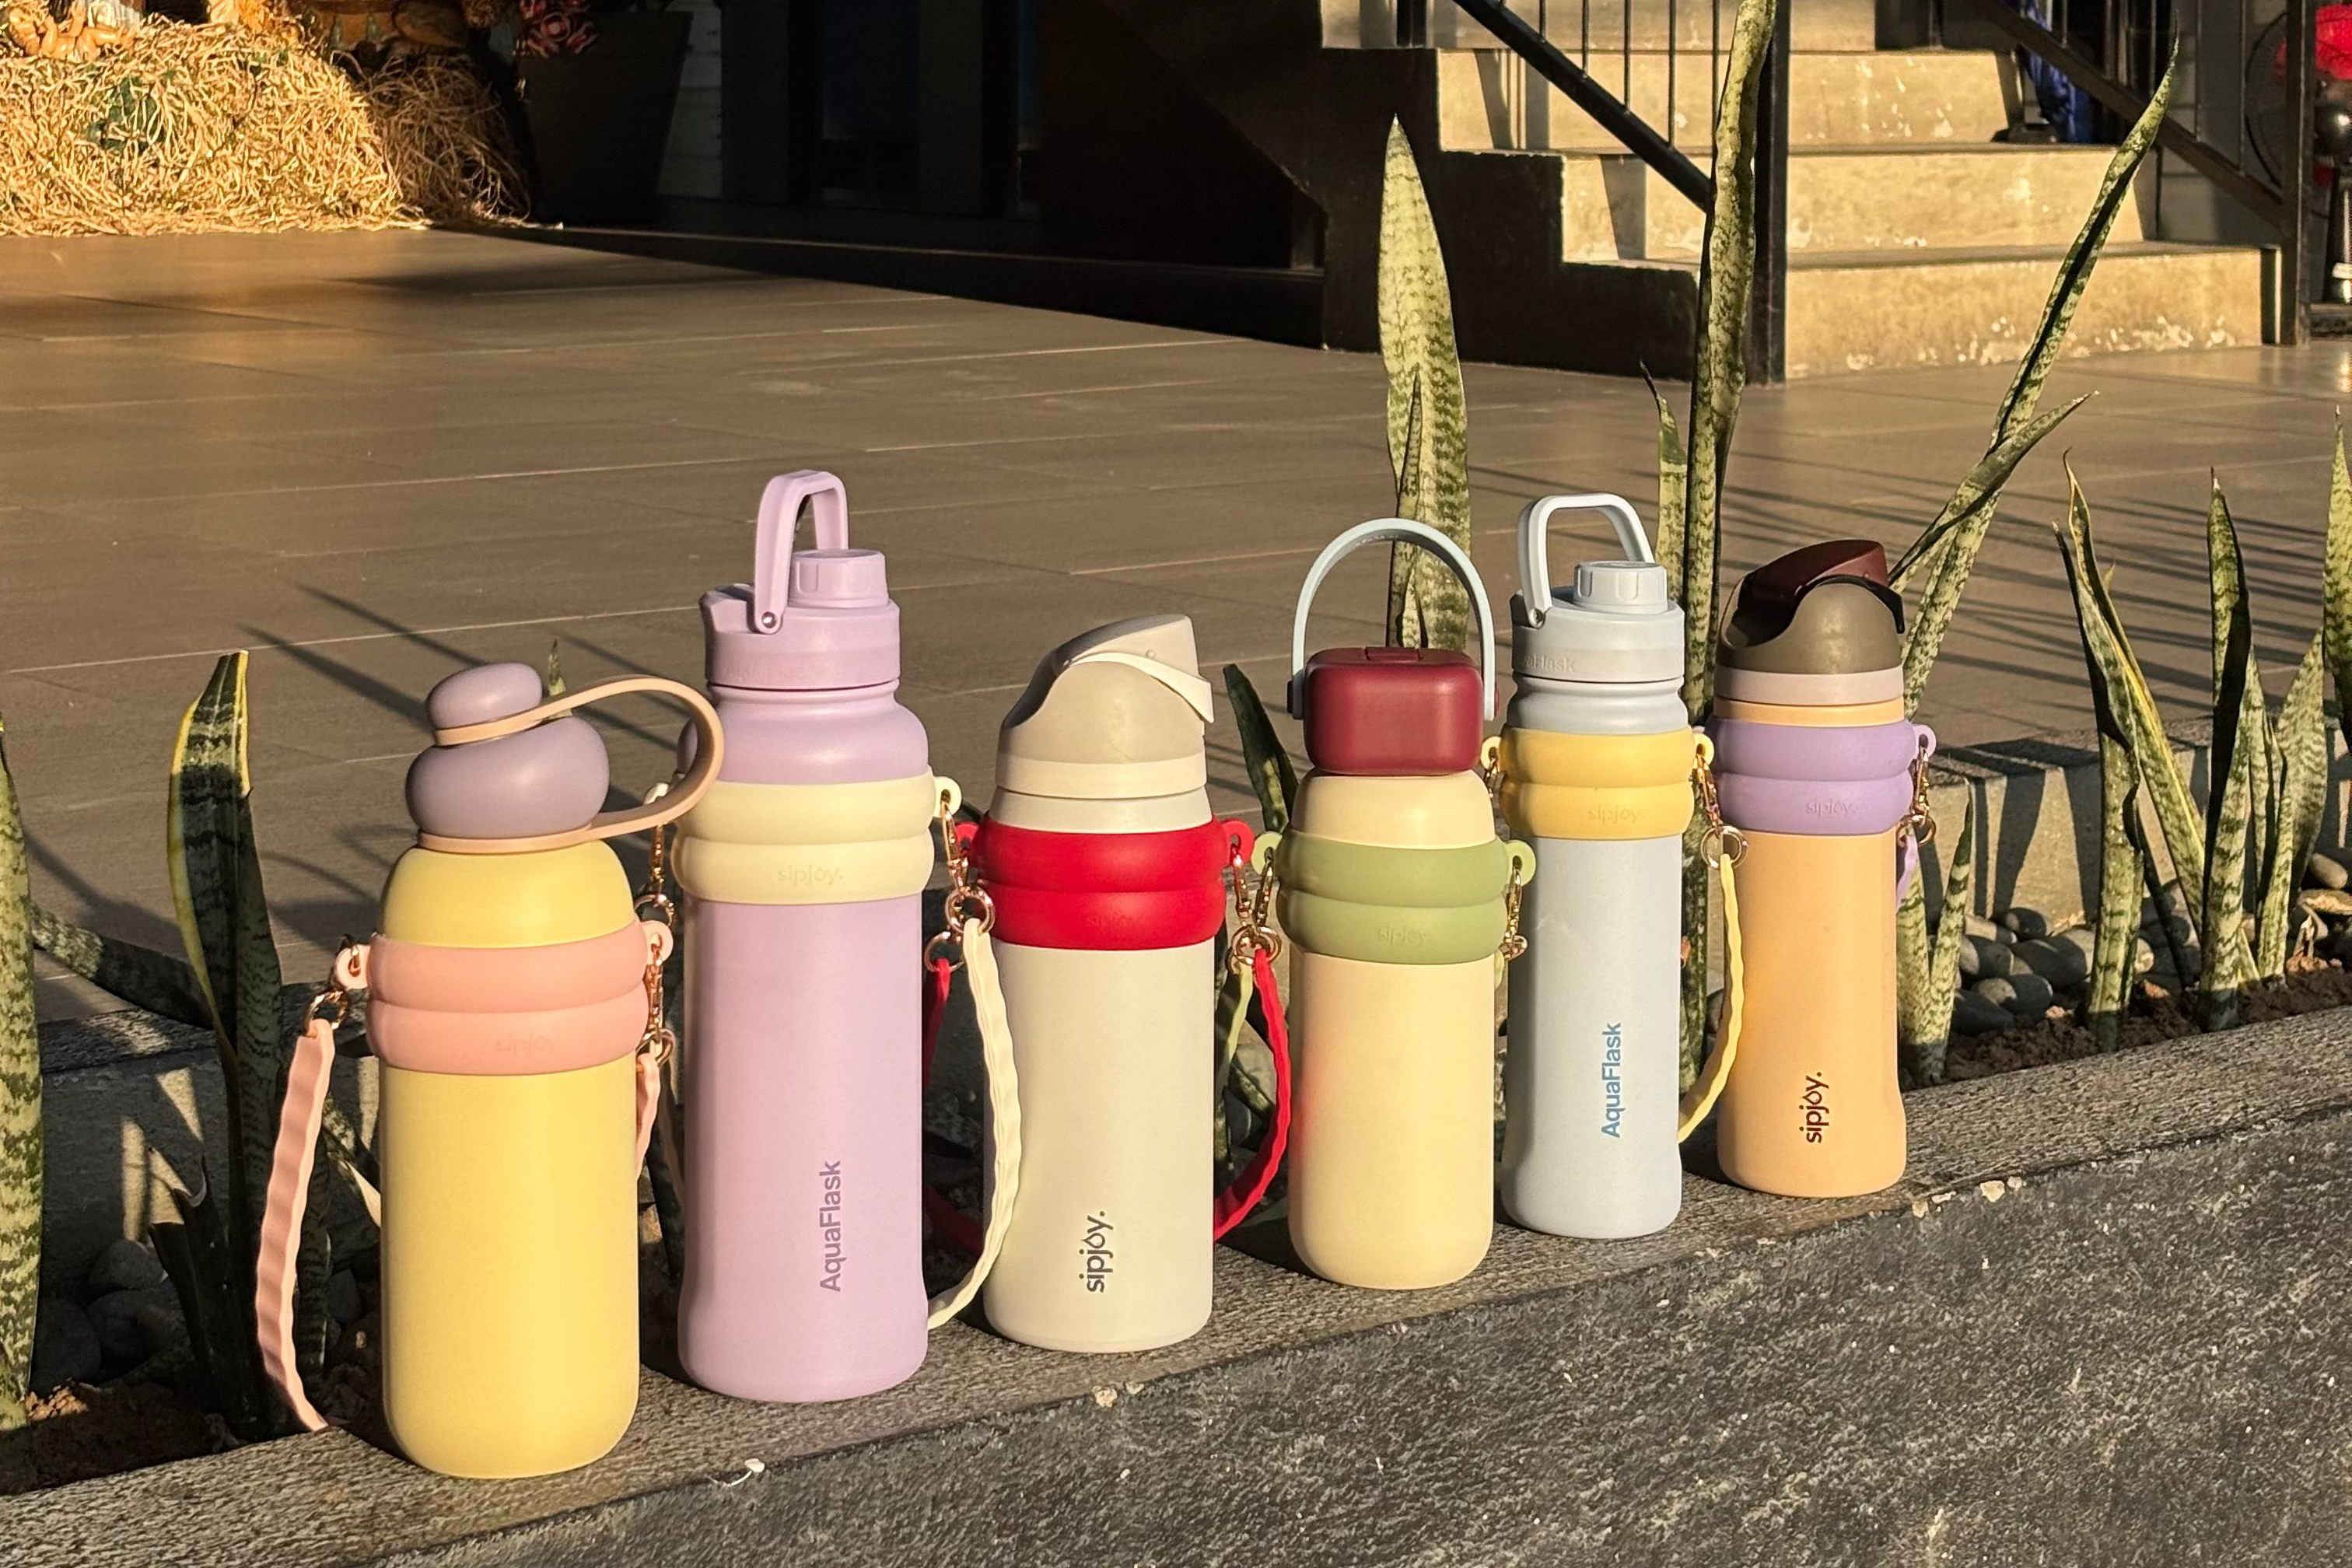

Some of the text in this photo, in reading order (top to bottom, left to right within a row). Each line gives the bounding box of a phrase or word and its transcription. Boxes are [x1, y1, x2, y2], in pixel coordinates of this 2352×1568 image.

[778, 864, 844, 887] sipjoy.
[1601, 1022, 1626, 1139] AquaFlask
[1799, 1071, 1829, 1144] sipjoy.
[819, 1160, 848, 1293] AquaFlask
[1079, 1210, 1114, 1293] sipjoy.
